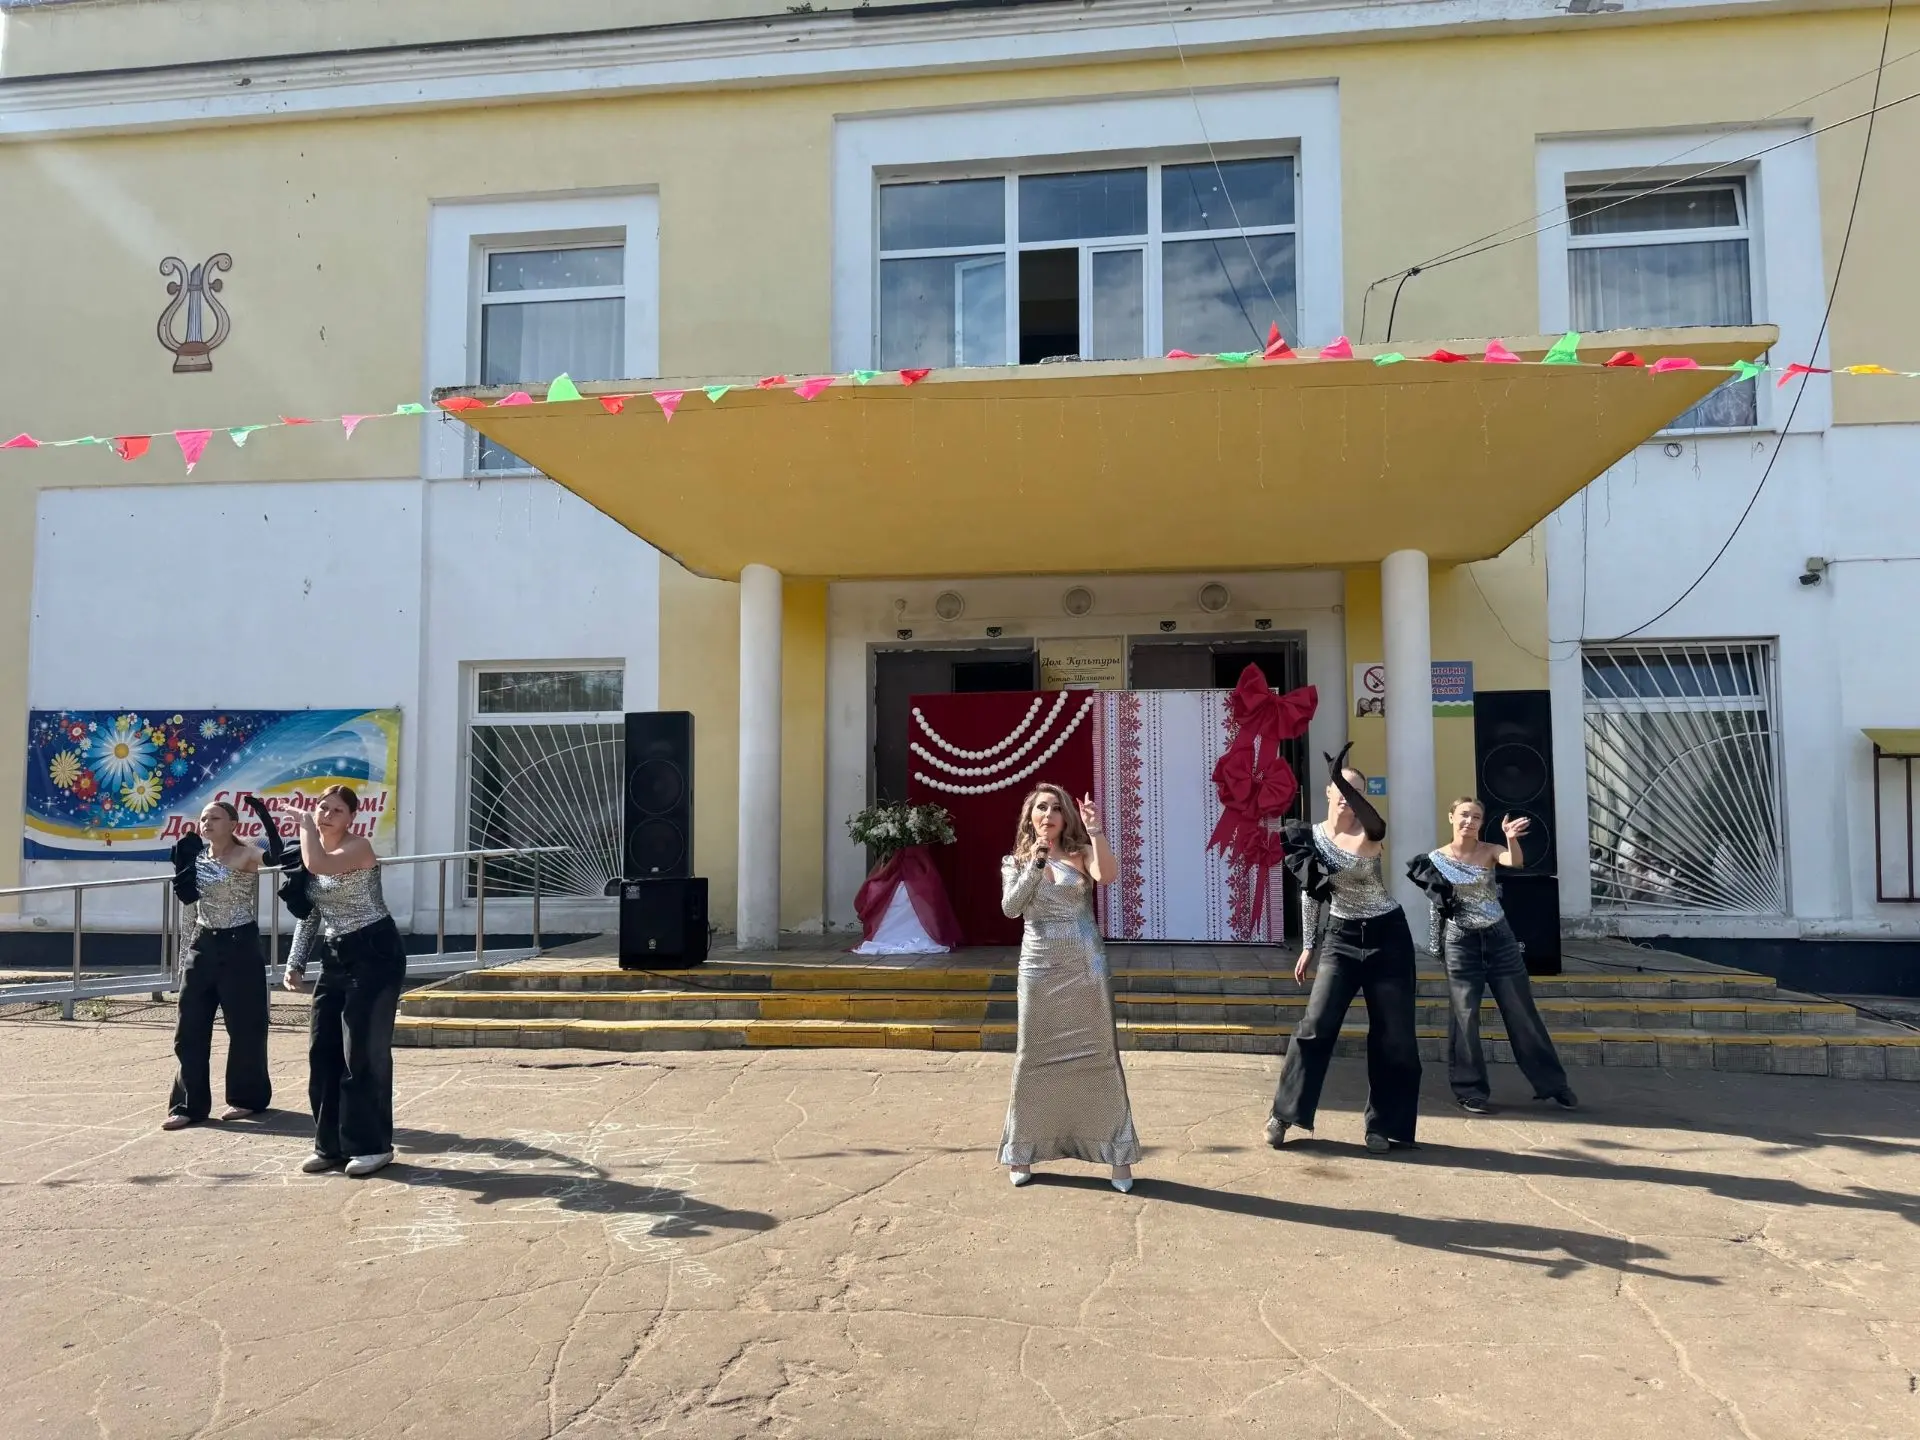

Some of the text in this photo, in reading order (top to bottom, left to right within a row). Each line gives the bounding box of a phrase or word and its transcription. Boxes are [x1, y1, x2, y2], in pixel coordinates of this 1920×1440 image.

[1041, 656, 1120, 668] Дом Культуры
[1431, 667, 1465, 675] ИТОРИЯ
